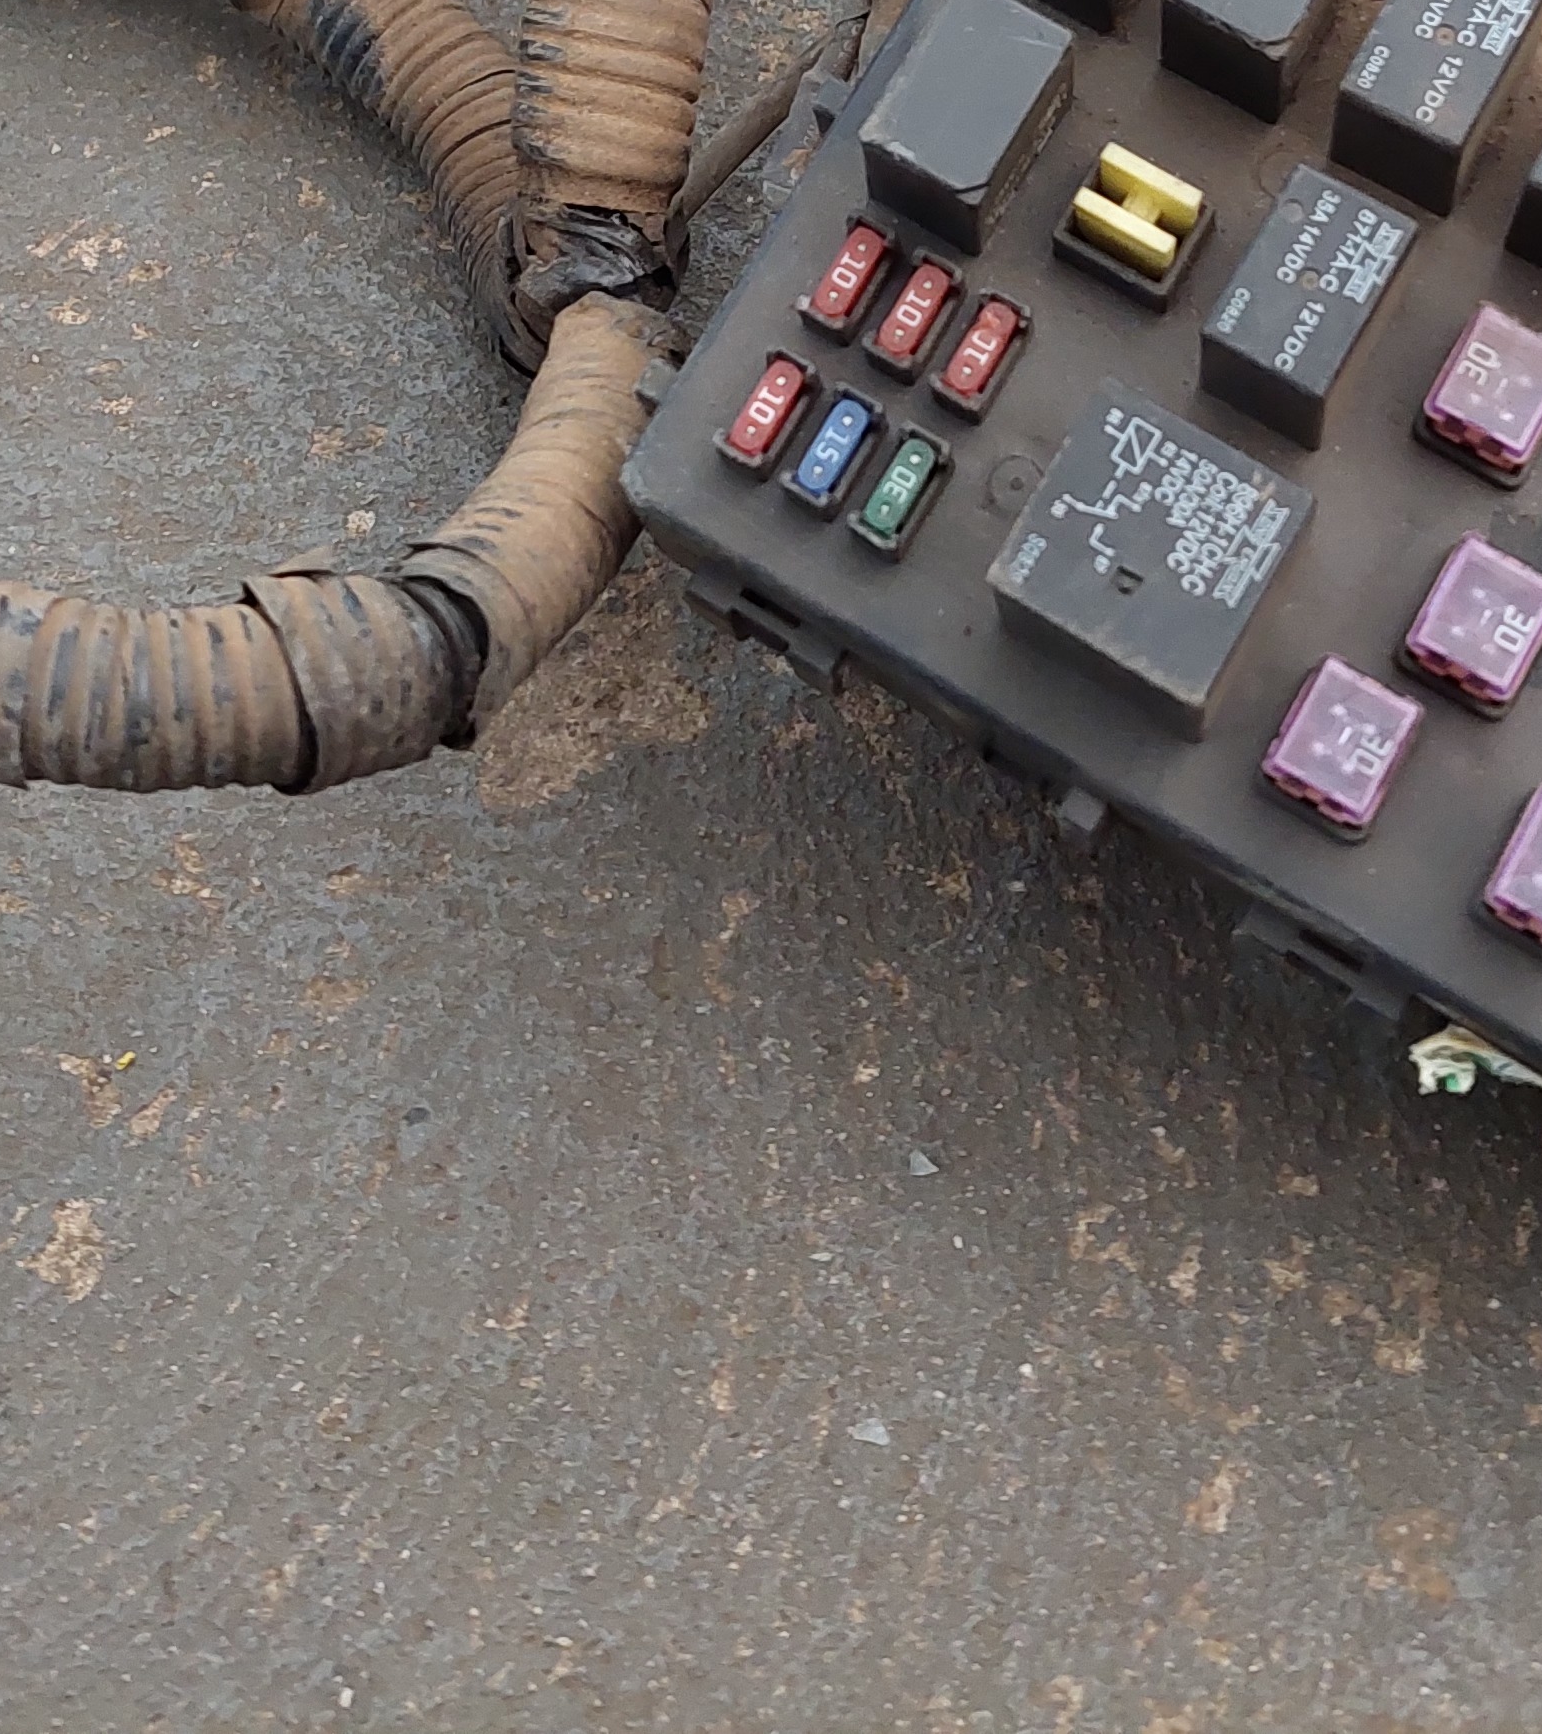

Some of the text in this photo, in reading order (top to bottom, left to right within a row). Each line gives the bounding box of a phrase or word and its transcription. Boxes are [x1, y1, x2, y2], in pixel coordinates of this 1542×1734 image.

[1416, 57, 1462, 122] 12VDC
[831, 252, 867, 290] 10
[1277, 226, 1320, 283] 14VDC
[896, 289, 932, 328] 10
[1275, 302, 1324, 371] 12VDC
[1460, 341, 1501, 387] 30
[748, 389, 786, 427] 10
[815, 426, 852, 462] 15
[881, 466, 917, 504] 30
[1493, 604, 1536, 654] 30
[1350, 725, 1393, 776] 30
